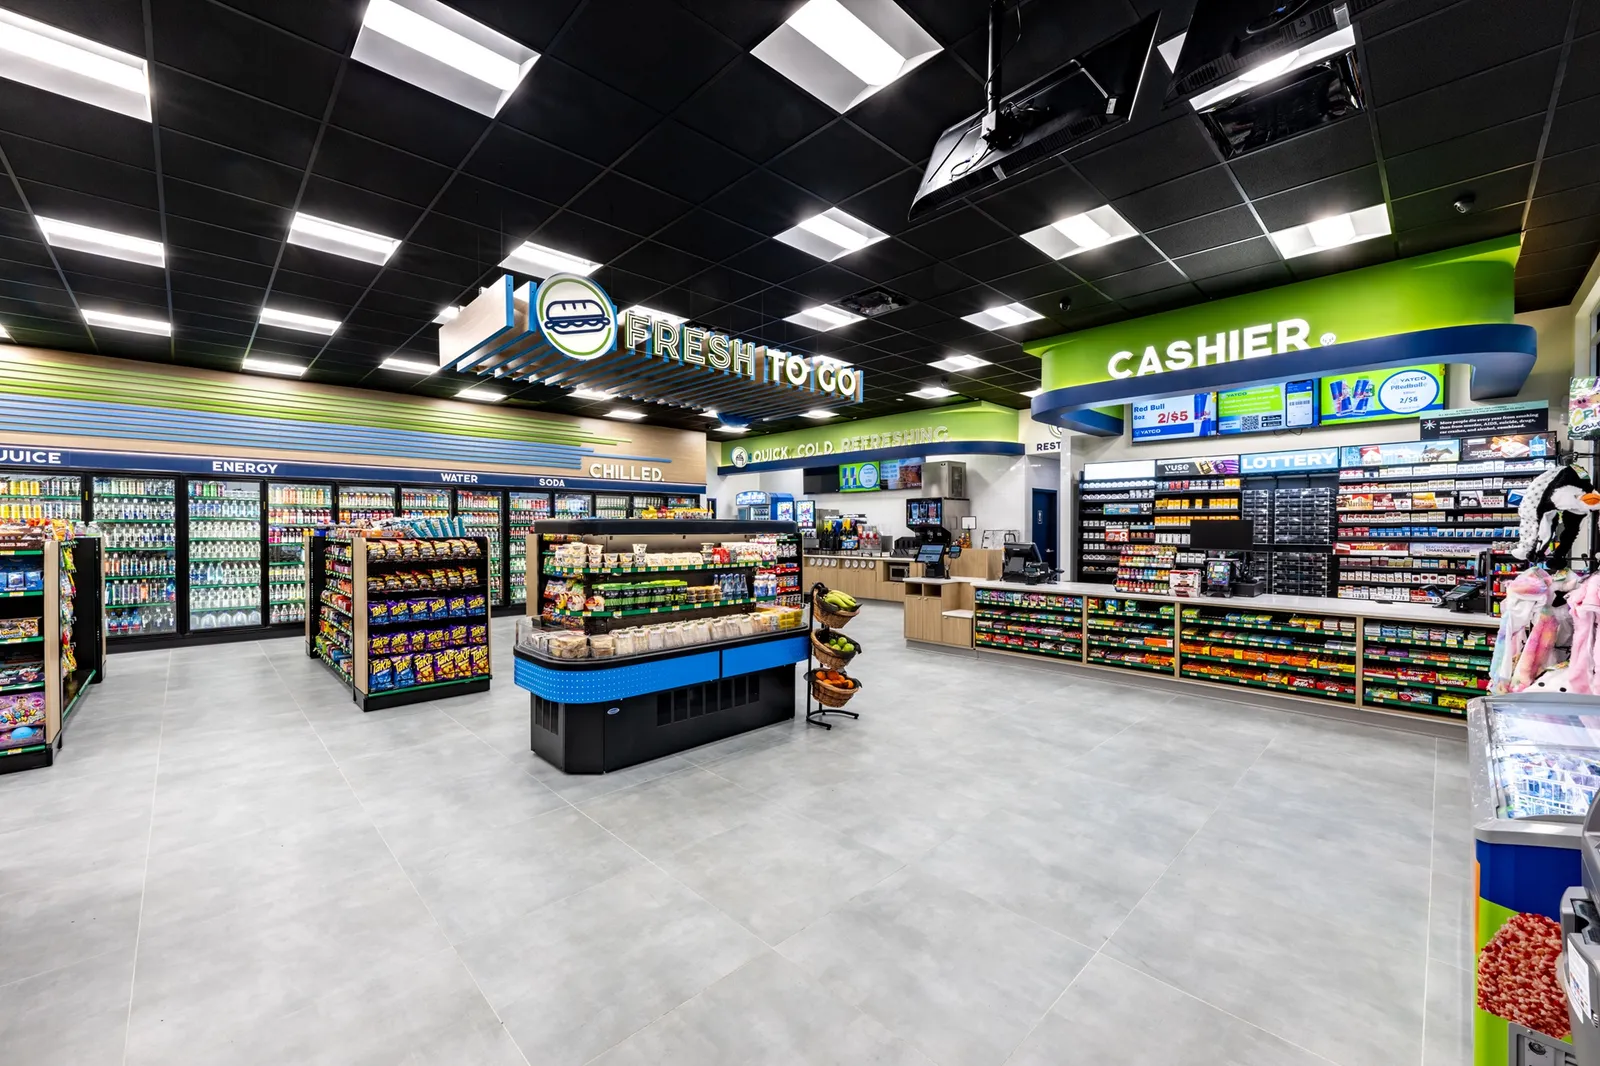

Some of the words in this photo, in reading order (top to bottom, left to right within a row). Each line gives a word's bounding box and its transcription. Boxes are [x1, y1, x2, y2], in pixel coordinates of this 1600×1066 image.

[625, 311, 755, 376] FRESH
[765, 348, 809, 386] TO
[817, 363, 857, 396] GO
[1134, 404, 1148, 413] Red
[1150, 403, 1165, 411] Bull
[1158, 411, 1189, 424] 2/$5
[0, 449, 62, 465] JUICE
[754, 445, 791, 463] QUICK.
[212, 461, 279, 474] ENERGY
[1243, 452, 1337, 471] LOTTERY
[441, 473, 479, 484] WATER
[589, 463, 665, 482] CHILLED.
[539, 478, 566, 488] SODA
